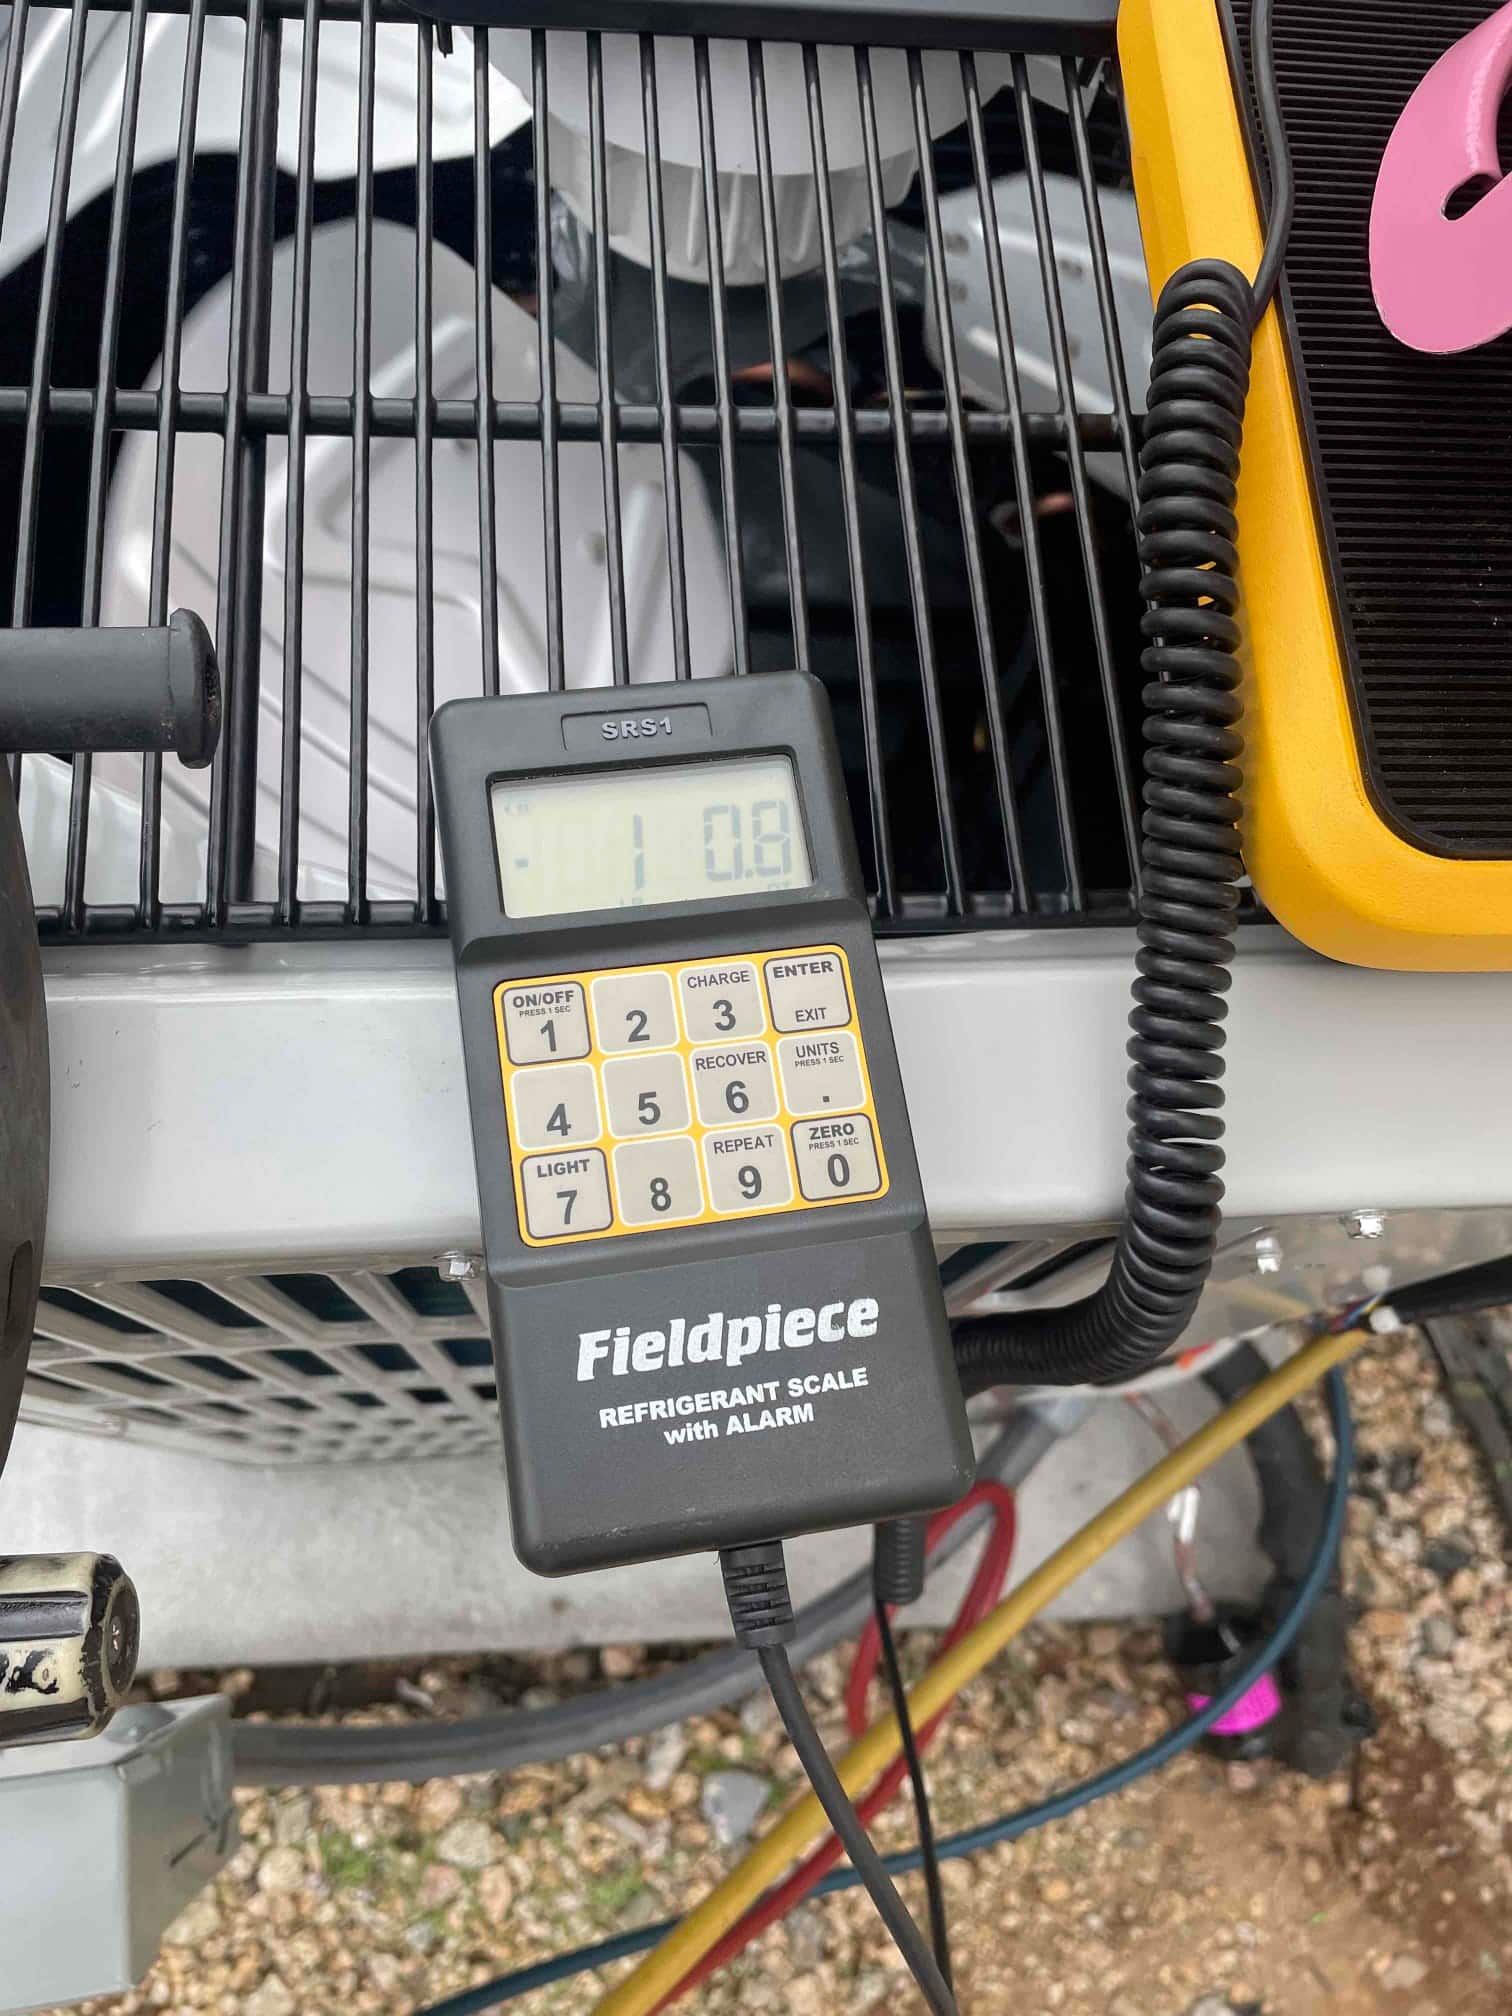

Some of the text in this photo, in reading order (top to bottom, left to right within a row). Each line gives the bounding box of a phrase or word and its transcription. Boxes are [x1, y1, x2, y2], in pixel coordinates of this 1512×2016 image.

[601, 715, 673, 741] SRS1
[703, 801, 792, 881] 0.8
[687, 970, 750, 990] CHARGE
[773, 960, 833, 979] ENTER
[512, 990, 575, 1009] ON/OFF
[519, 1008, 546, 1017] PRESS
[554, 1005, 571, 1014] SEC
[712, 999, 737, 1031] 3
[795, 1007, 827, 1023] EXIT
[540, 1019, 558, 1053] 1
[626, 1009, 651, 1043] 2
[695, 1050, 767, 1071] RECOVER
[794, 1058, 822, 1068] PRESS
[829, 1055, 845, 1065] SEC
[795, 1041, 840, 1059] UNITS
[637, 1091, 661, 1126] 5
[725, 1080, 750, 1114] 6
[546, 1103, 572, 1137] 4
[809, 1122, 855, 1141] ZERO
[713, 1134, 775, 1155] REPEAT
[809, 1141, 836, 1151] PRESS
[843, 1138, 860, 1148] SEC
[536, 1159, 590, 1178] LIGHT
[737, 1165, 763, 1200] 9
[826, 1153, 850, 1188] 0
[556, 1190, 578, 1225] 7
[649, 1177, 672, 1212] 8
[576, 1297, 879, 1382] Fieldpiece
[599, 1367, 869, 1429] REFRIGERANT SCALE
[664, 1403, 814, 1445] with ALARM
